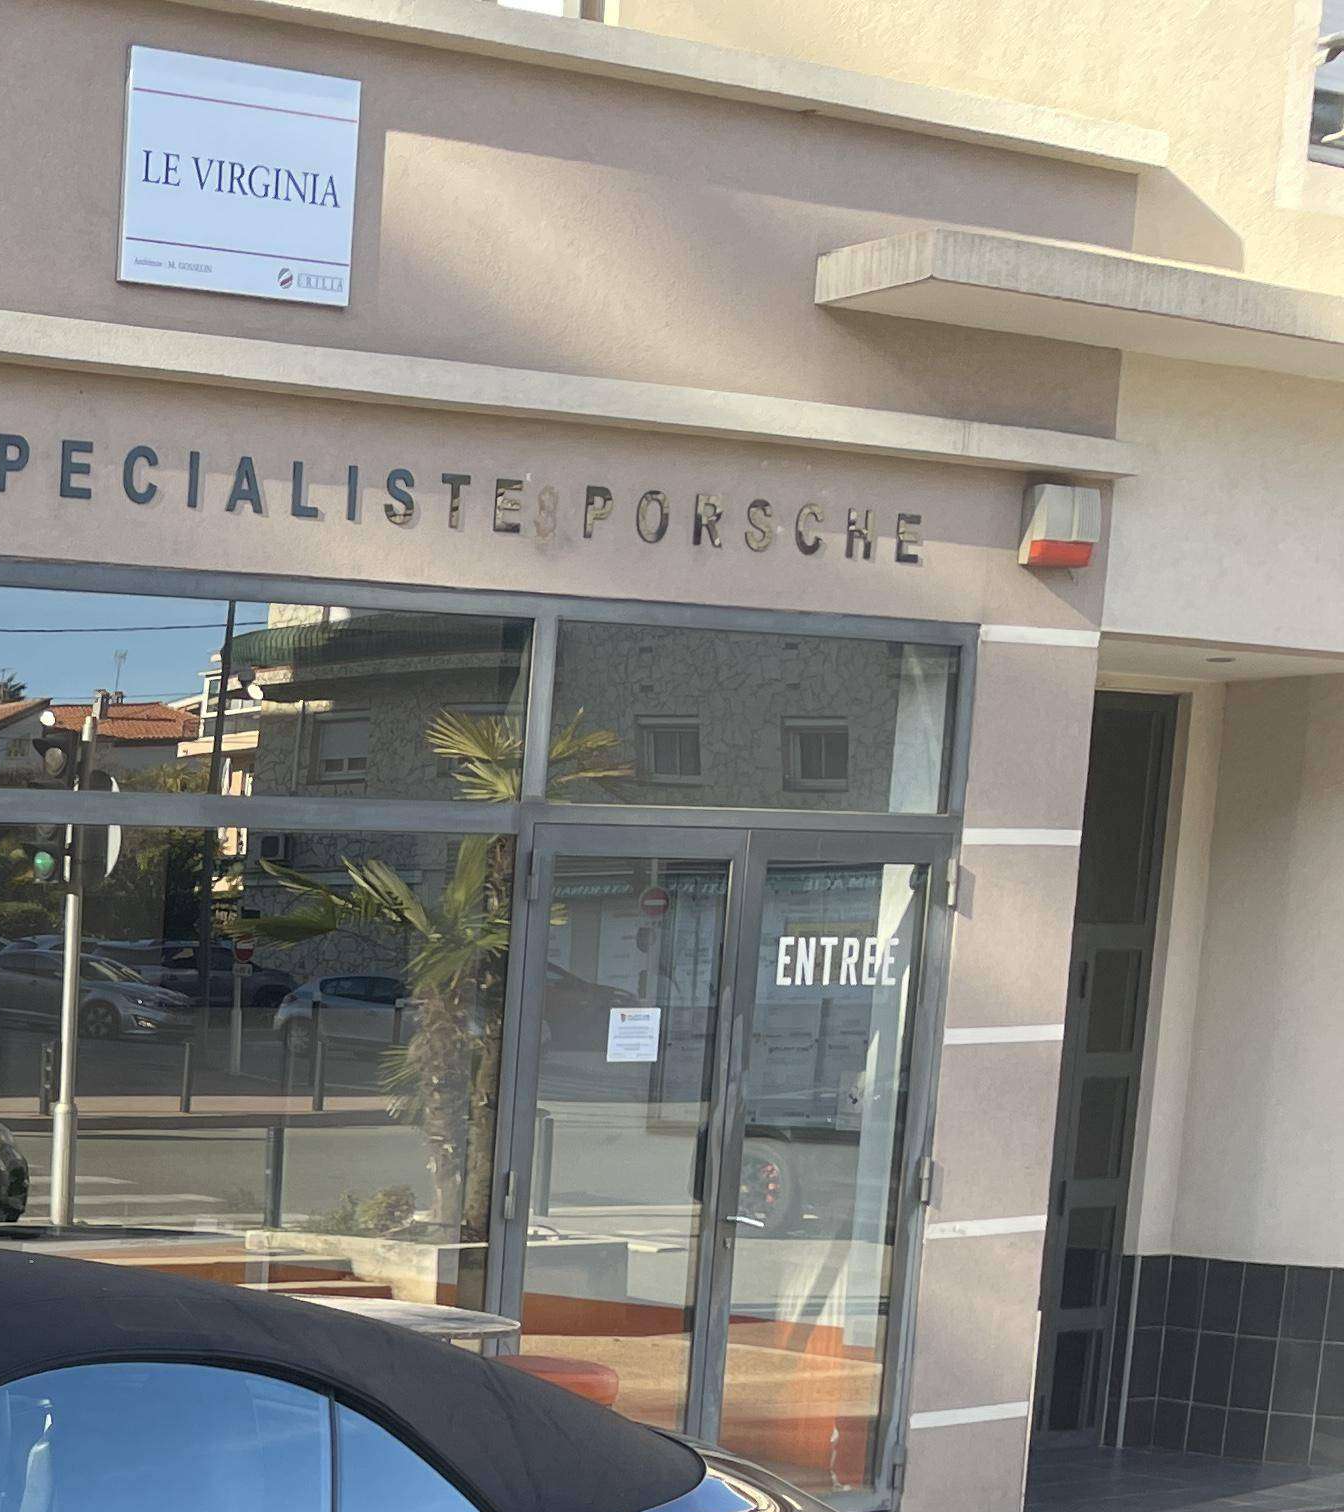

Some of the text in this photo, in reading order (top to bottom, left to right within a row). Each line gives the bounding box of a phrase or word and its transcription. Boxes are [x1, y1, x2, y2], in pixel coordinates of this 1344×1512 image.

[142, 149, 341, 209] LE VIRGINIA
[582, 485, 923, 564] PORSCHE
[776, 936, 899, 986] ENTREE
